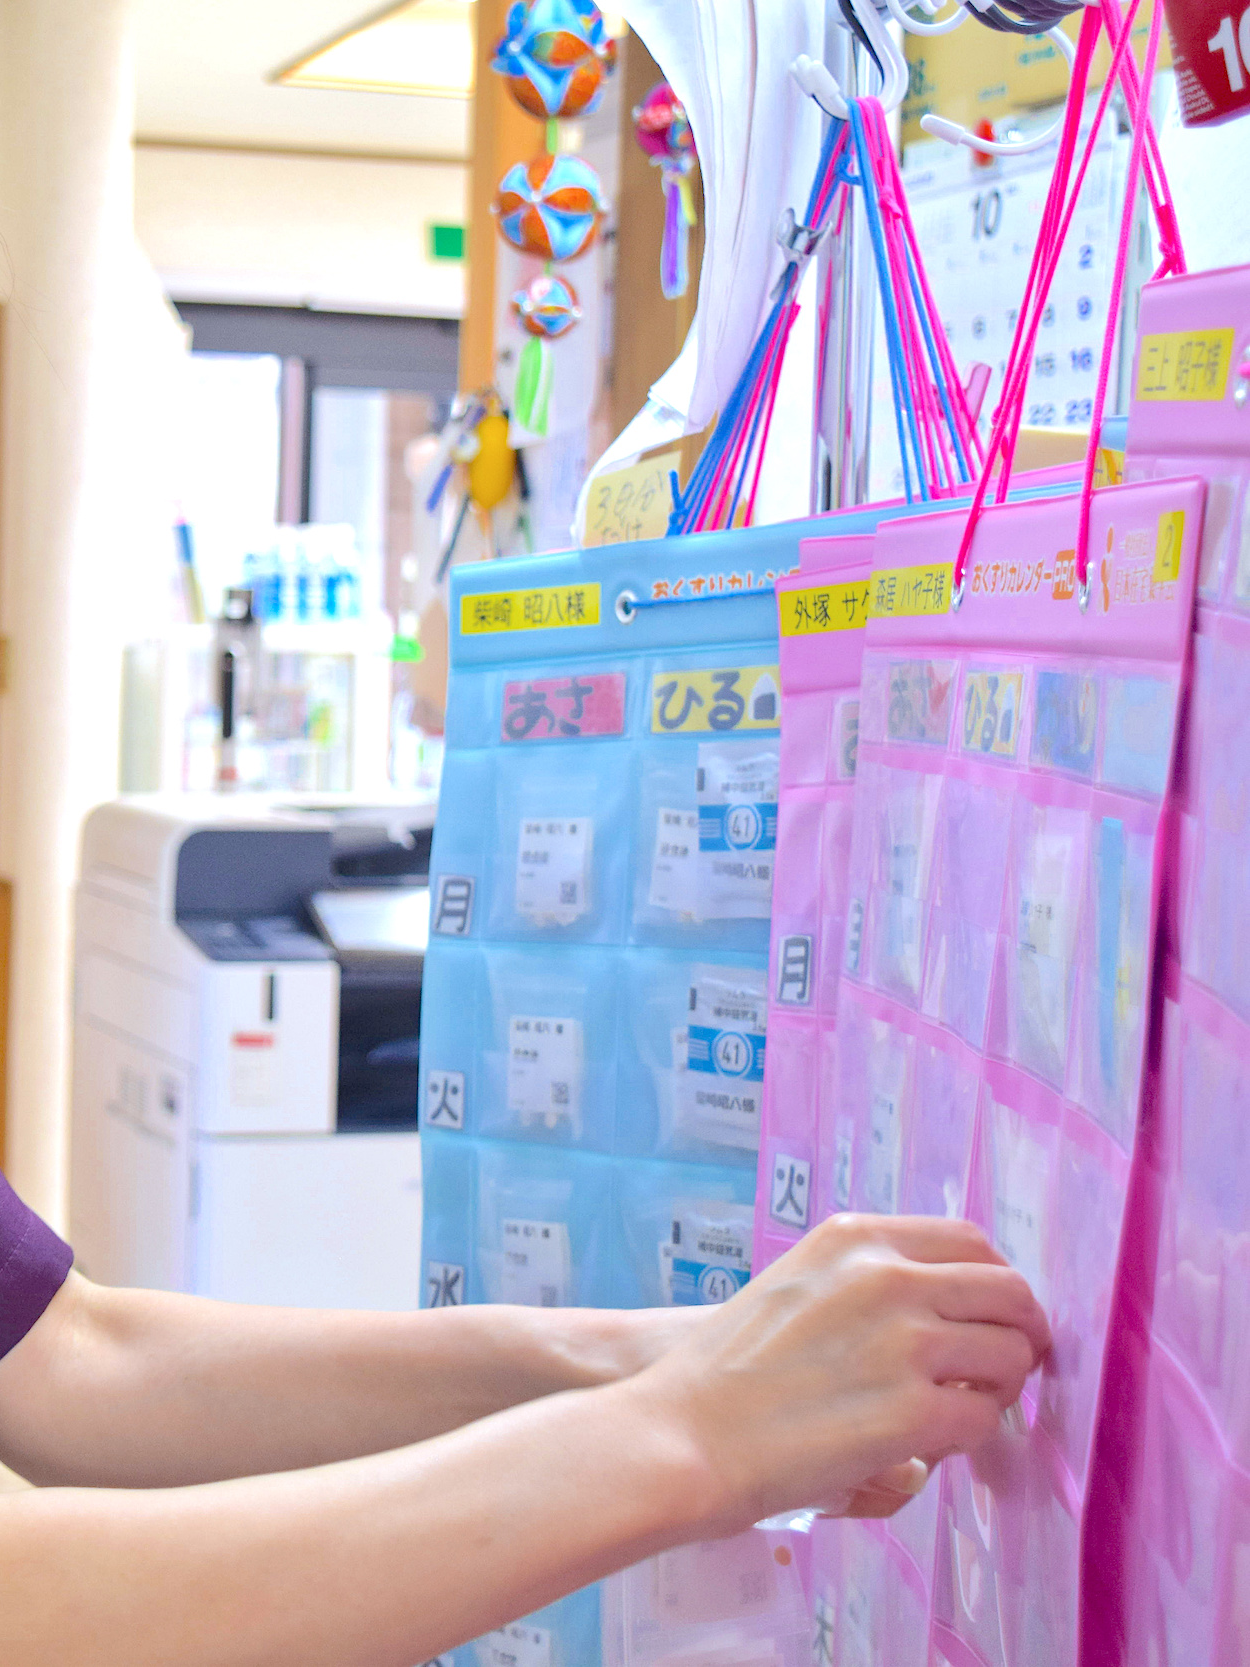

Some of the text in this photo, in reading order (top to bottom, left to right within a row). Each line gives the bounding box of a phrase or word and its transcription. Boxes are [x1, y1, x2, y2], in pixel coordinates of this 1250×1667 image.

[973, 189, 1002, 239] 10
[1078, 244, 1094, 270] 2
[1161, 523, 1174, 568] 2
[795, 593, 831, 630] 外塚
[503, 676, 594, 740] あさ
[653, 670, 745, 731] ひる
[731, 814, 750, 839] 41
[435, 879, 472, 933] 月
[779, 937, 810, 1001] 月
[721, 1041, 740, 1066] 41
[430, 1077, 460, 1122] 火
[775, 1163, 805, 1218] 火
